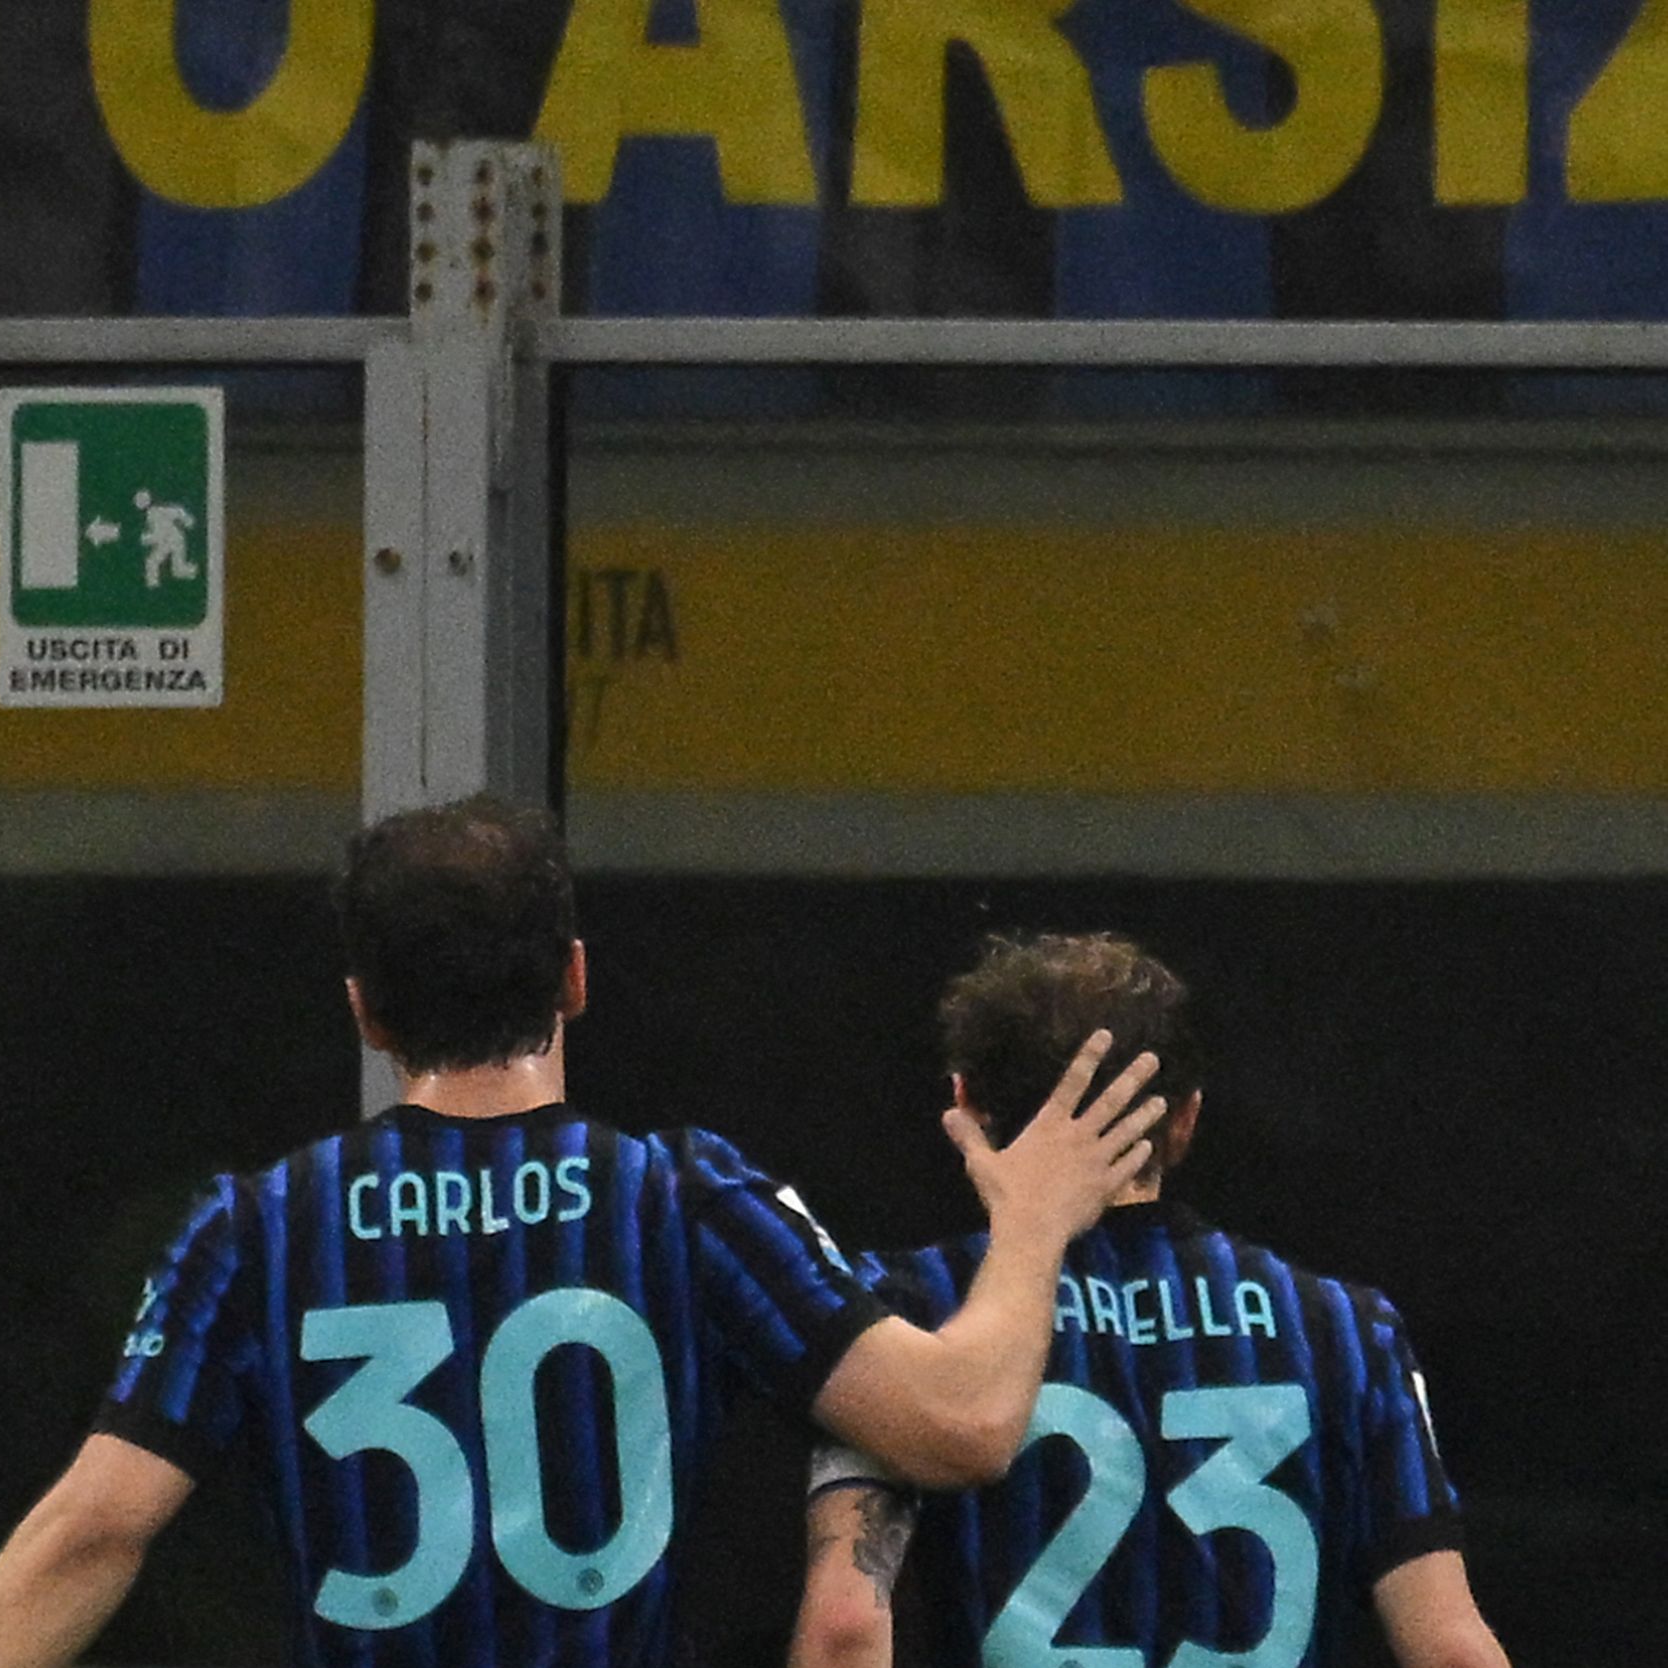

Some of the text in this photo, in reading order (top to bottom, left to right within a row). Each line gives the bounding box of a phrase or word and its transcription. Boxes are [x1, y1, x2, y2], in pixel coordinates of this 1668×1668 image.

[26, 637, 190, 662] USCITA DI
[8, 669, 208, 693] EMERGENZA
[347, 1155, 593, 1241] CARLOS
[299, 1285, 677, 1631] 30
